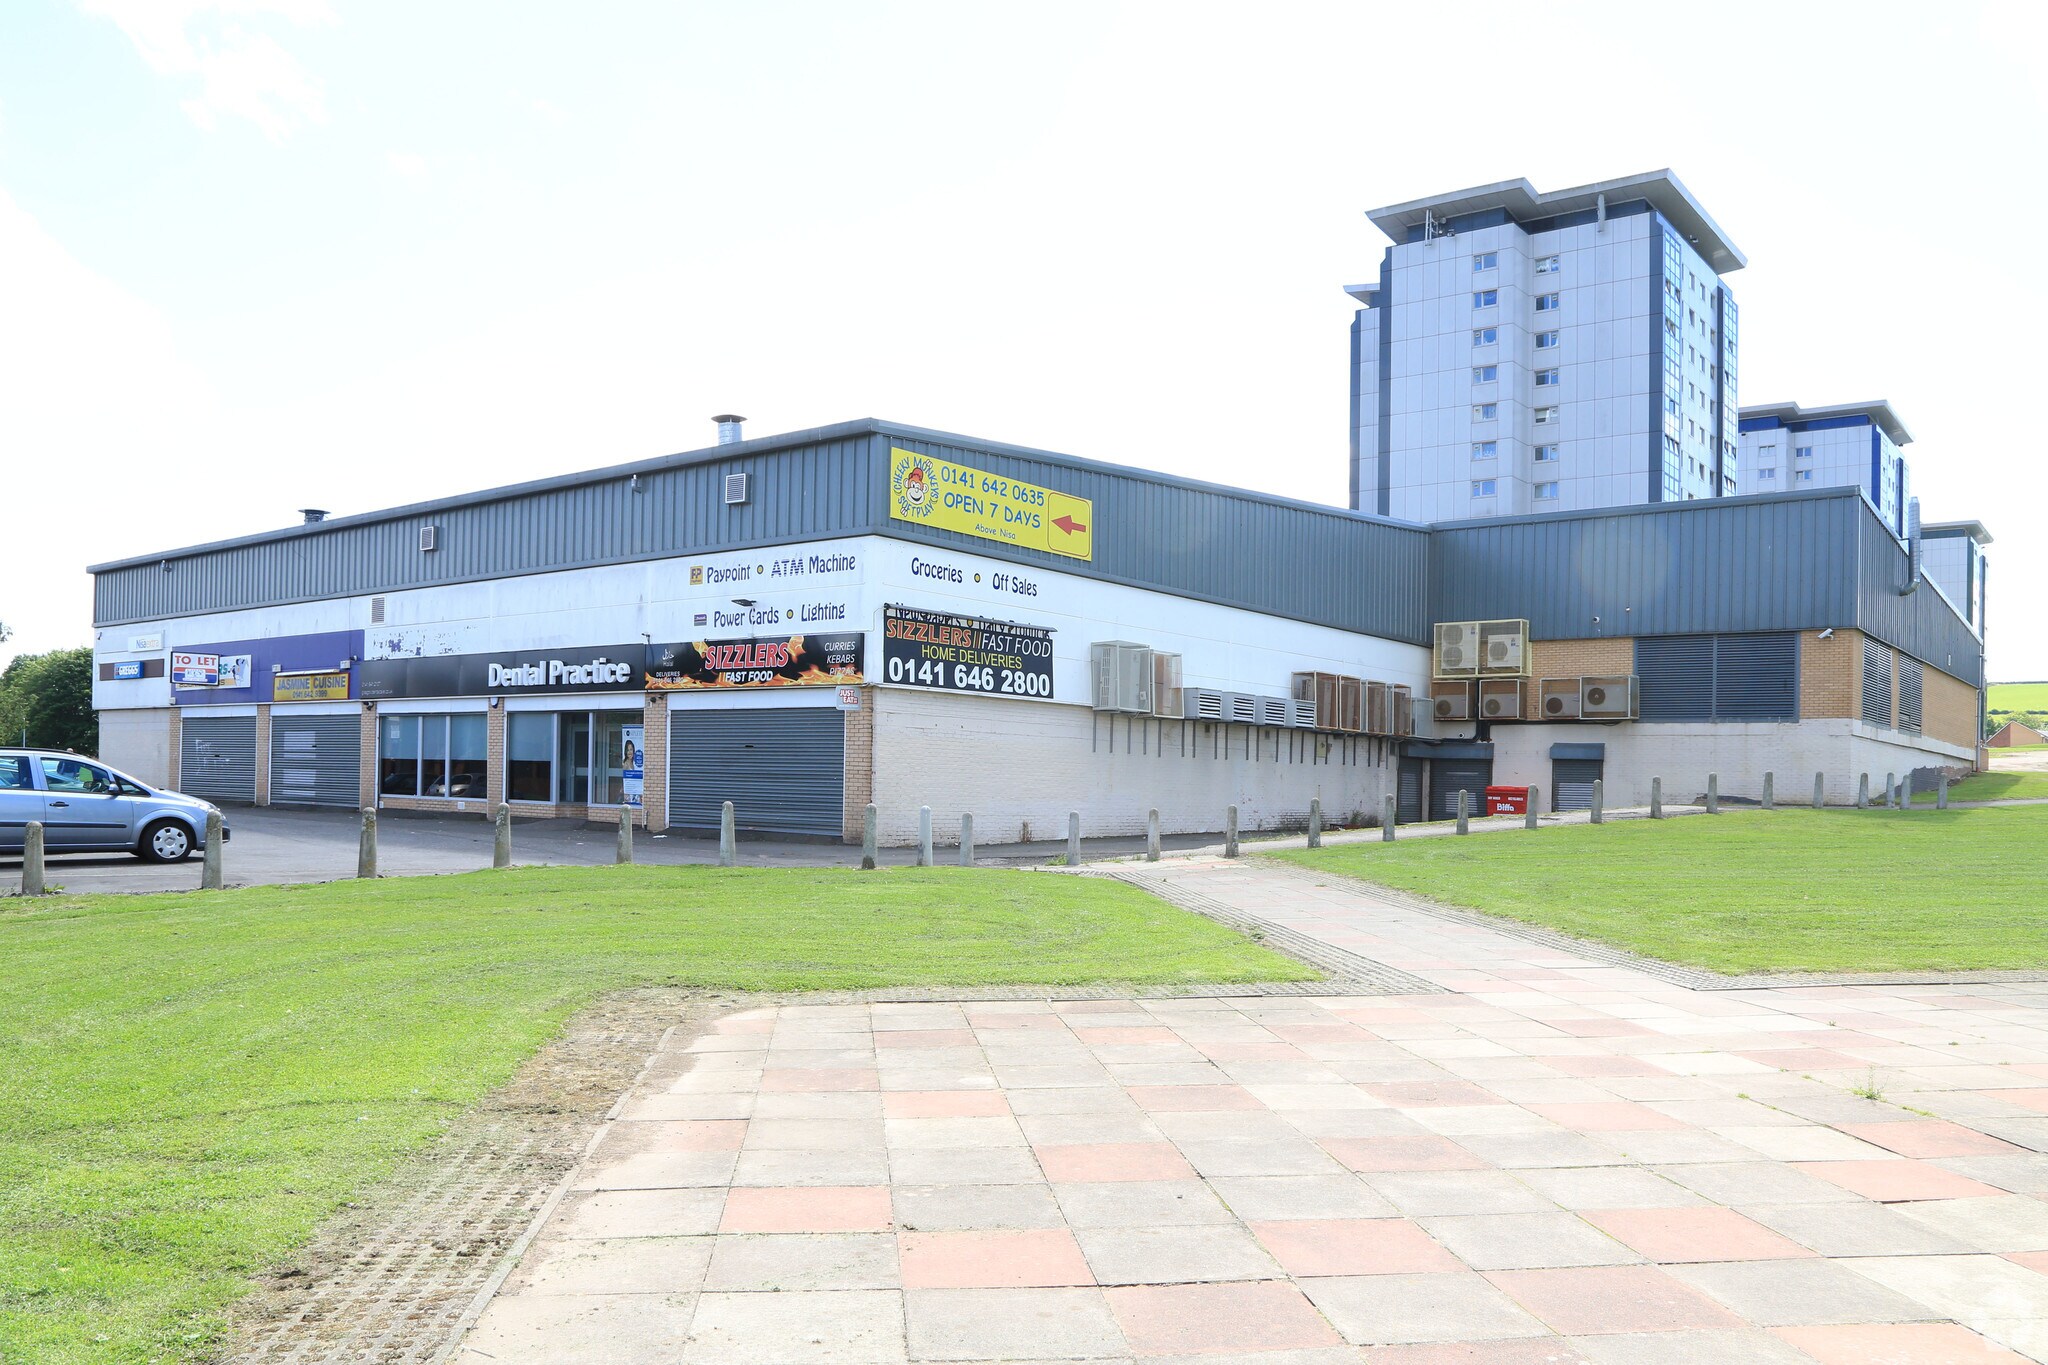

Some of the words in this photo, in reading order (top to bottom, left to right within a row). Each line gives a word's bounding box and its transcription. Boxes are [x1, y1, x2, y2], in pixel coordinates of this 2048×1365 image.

[893, 456, 910, 490] CHEEKY
[913, 456, 940, 499] MONKEYS
[941, 465, 975, 489] 0141
[982, 477, 1008, 497] 642
[1012, 484, 1045, 507] 0635
[943, 492, 984, 515] OPEN
[989, 502, 999, 518] 7
[1004, 506, 1041, 529] DAYS
[975, 523, 997, 536] Above
[1000, 528, 1016, 540] Nisa
[707, 564, 751, 584] Paypoint
[771, 558, 804, 578] ATM
[808, 553, 856, 574] Machine
[911, 557, 963, 584] Groceries
[992, 572, 1009, 592] Off
[1011, 576, 1038, 597] Sales
[714, 610, 746, 628] Power
[749, 607, 779, 625] Cards
[801, 602, 846, 622] Lighting
[824, 641, 856, 652] CURRIES
[886, 618, 972, 648] SIZZLERS
[981, 633, 1012, 653] FAST
[1014, 638, 1051, 658] FOOD
[174, 655, 192, 665] TO
[197, 656, 217, 666] LET
[705, 642, 789, 670] SIZZLERS
[826, 654, 855, 664] KEBABS
[921, 644, 956, 662] HOME
[959, 649, 1023, 669] DELIVERIES
[118, 665, 139, 676] GREGGS
[488, 660, 547, 687] Dental
[548, 657, 631, 685] Practice
[725, 671, 747, 683] FAST
[748, 670, 774, 682] FOOD
[829, 666, 855, 677] PIZZAS
[888, 656, 945, 686] 0141
[954, 664, 994, 691] 646
[1001, 669, 1050, 697] 2800
[277, 678, 310, 690] JASMINE
[313, 676, 346, 689] CUISINE
[839, 689, 855, 697] JUST
[843, 696, 854, 704] EAT
[1496, 803, 1515, 812] Biffa
